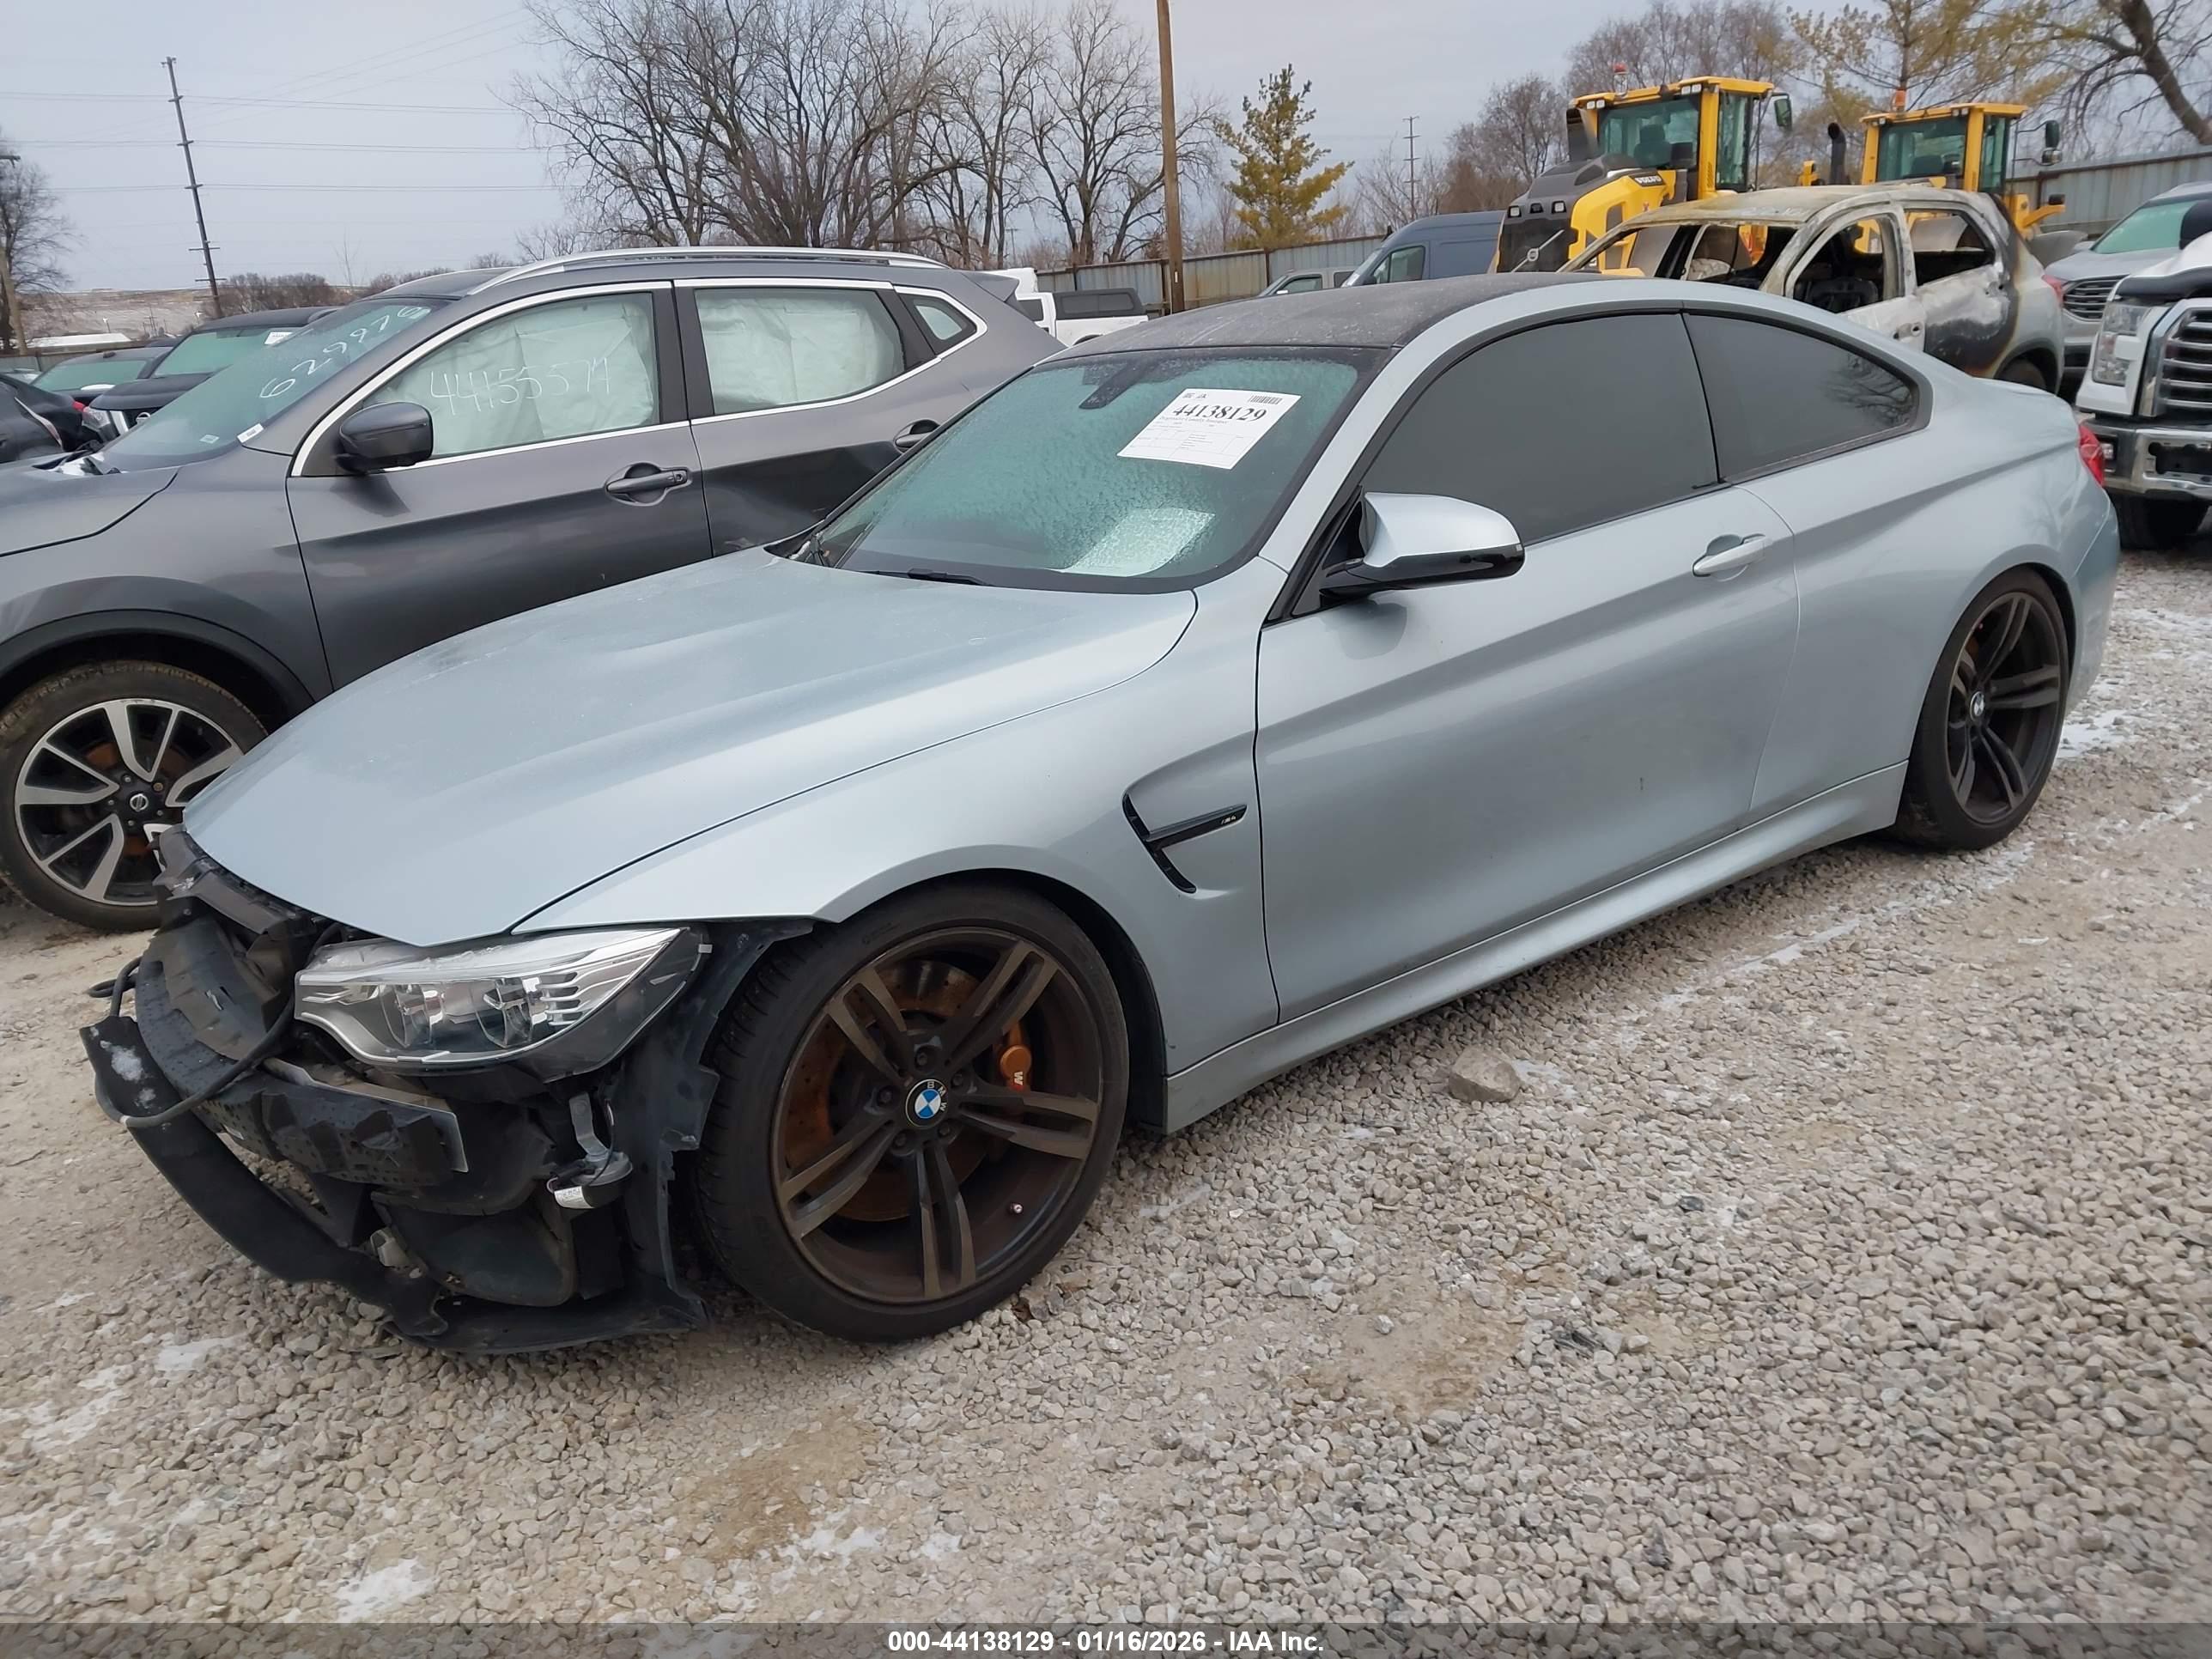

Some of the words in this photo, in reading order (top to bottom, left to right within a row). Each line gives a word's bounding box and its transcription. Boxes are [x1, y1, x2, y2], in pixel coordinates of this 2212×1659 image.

[430, 356, 612, 416] 44155574
[1172, 404, 1268, 422] 44138129
[927, 1080, 948, 1112] BMW
